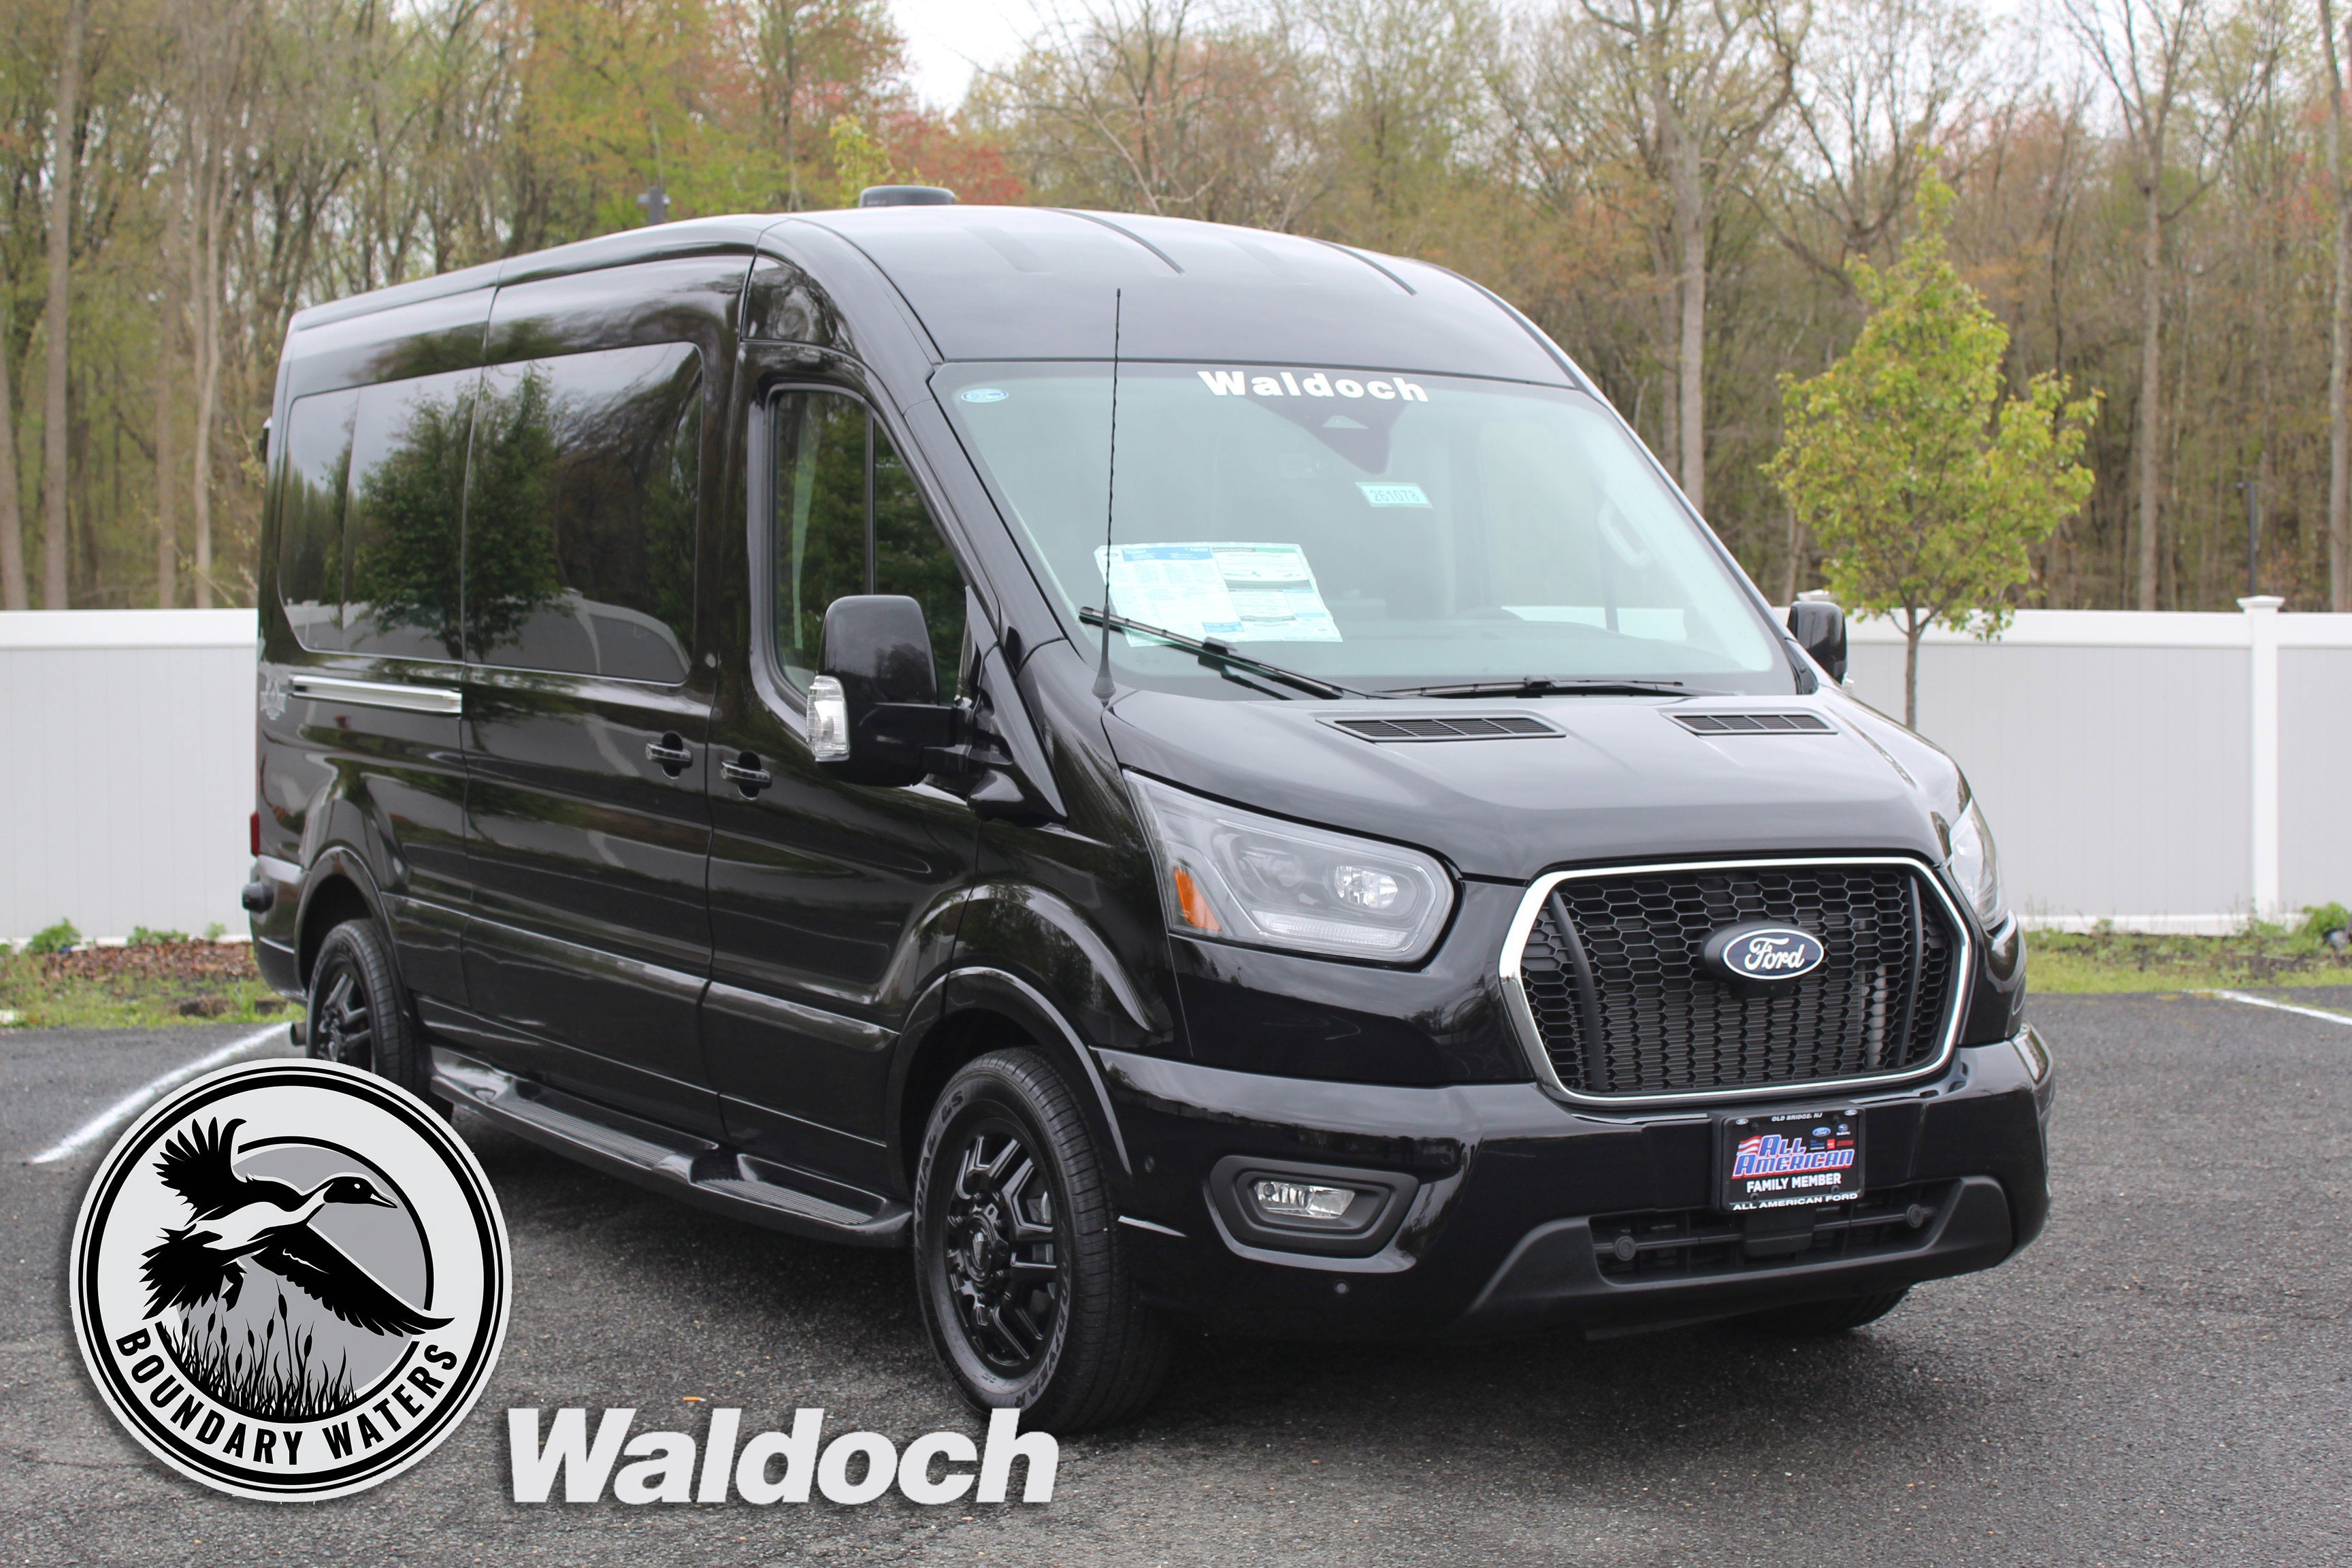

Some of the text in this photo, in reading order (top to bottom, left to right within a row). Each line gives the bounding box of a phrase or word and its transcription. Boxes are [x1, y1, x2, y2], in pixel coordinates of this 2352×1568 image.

[1196, 371, 1429, 402] Waldoch
[1369, 489, 1420, 502] 261078
[1744, 936, 1806, 970] Ford
[1758, 1134, 1807, 1157] ALL
[1746, 1172, 1842, 1194] FAMILY MEMBER
[1733, 1192, 1859, 1211] ALL AMERICAN FORD
